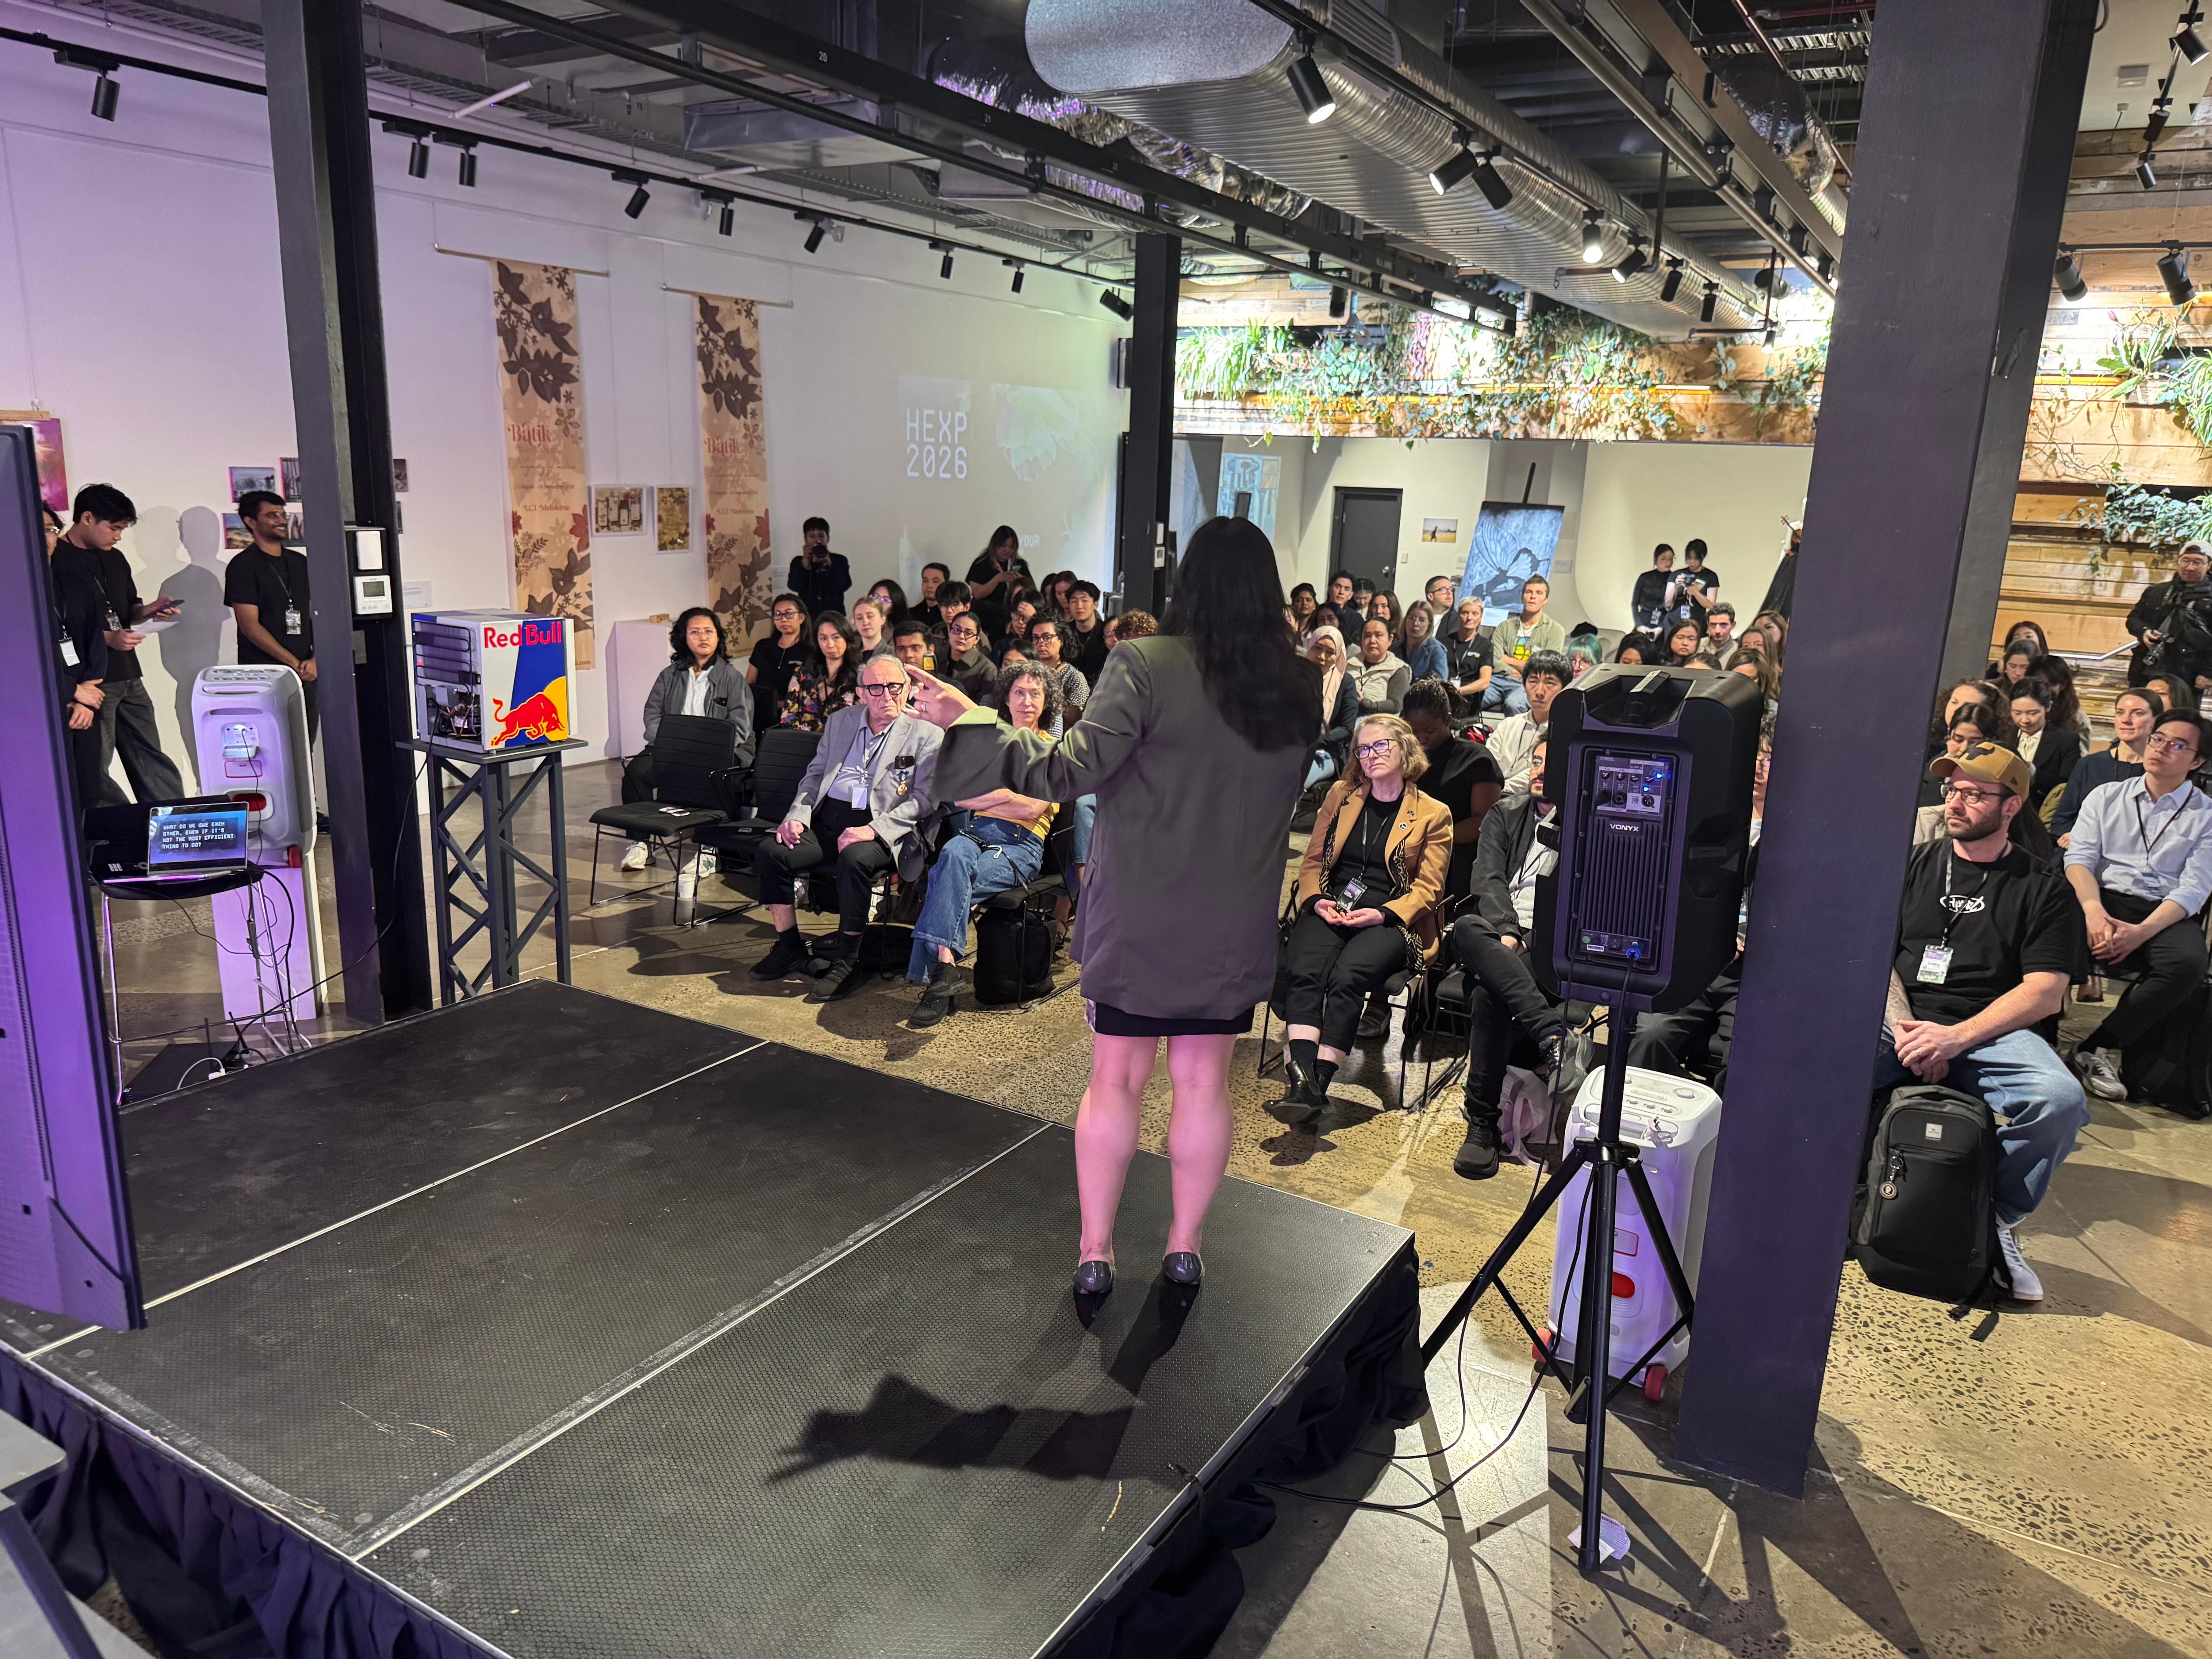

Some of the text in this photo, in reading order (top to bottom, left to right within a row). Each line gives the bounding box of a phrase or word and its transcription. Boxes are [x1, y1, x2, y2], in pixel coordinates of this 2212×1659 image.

[818, 51, 827, 62] 20
[508, 422, 551, 448] Batik
[907, 408, 967, 444] HEXP
[907, 444, 967, 479] 2026
[484, 621, 561, 649] Red Bull
